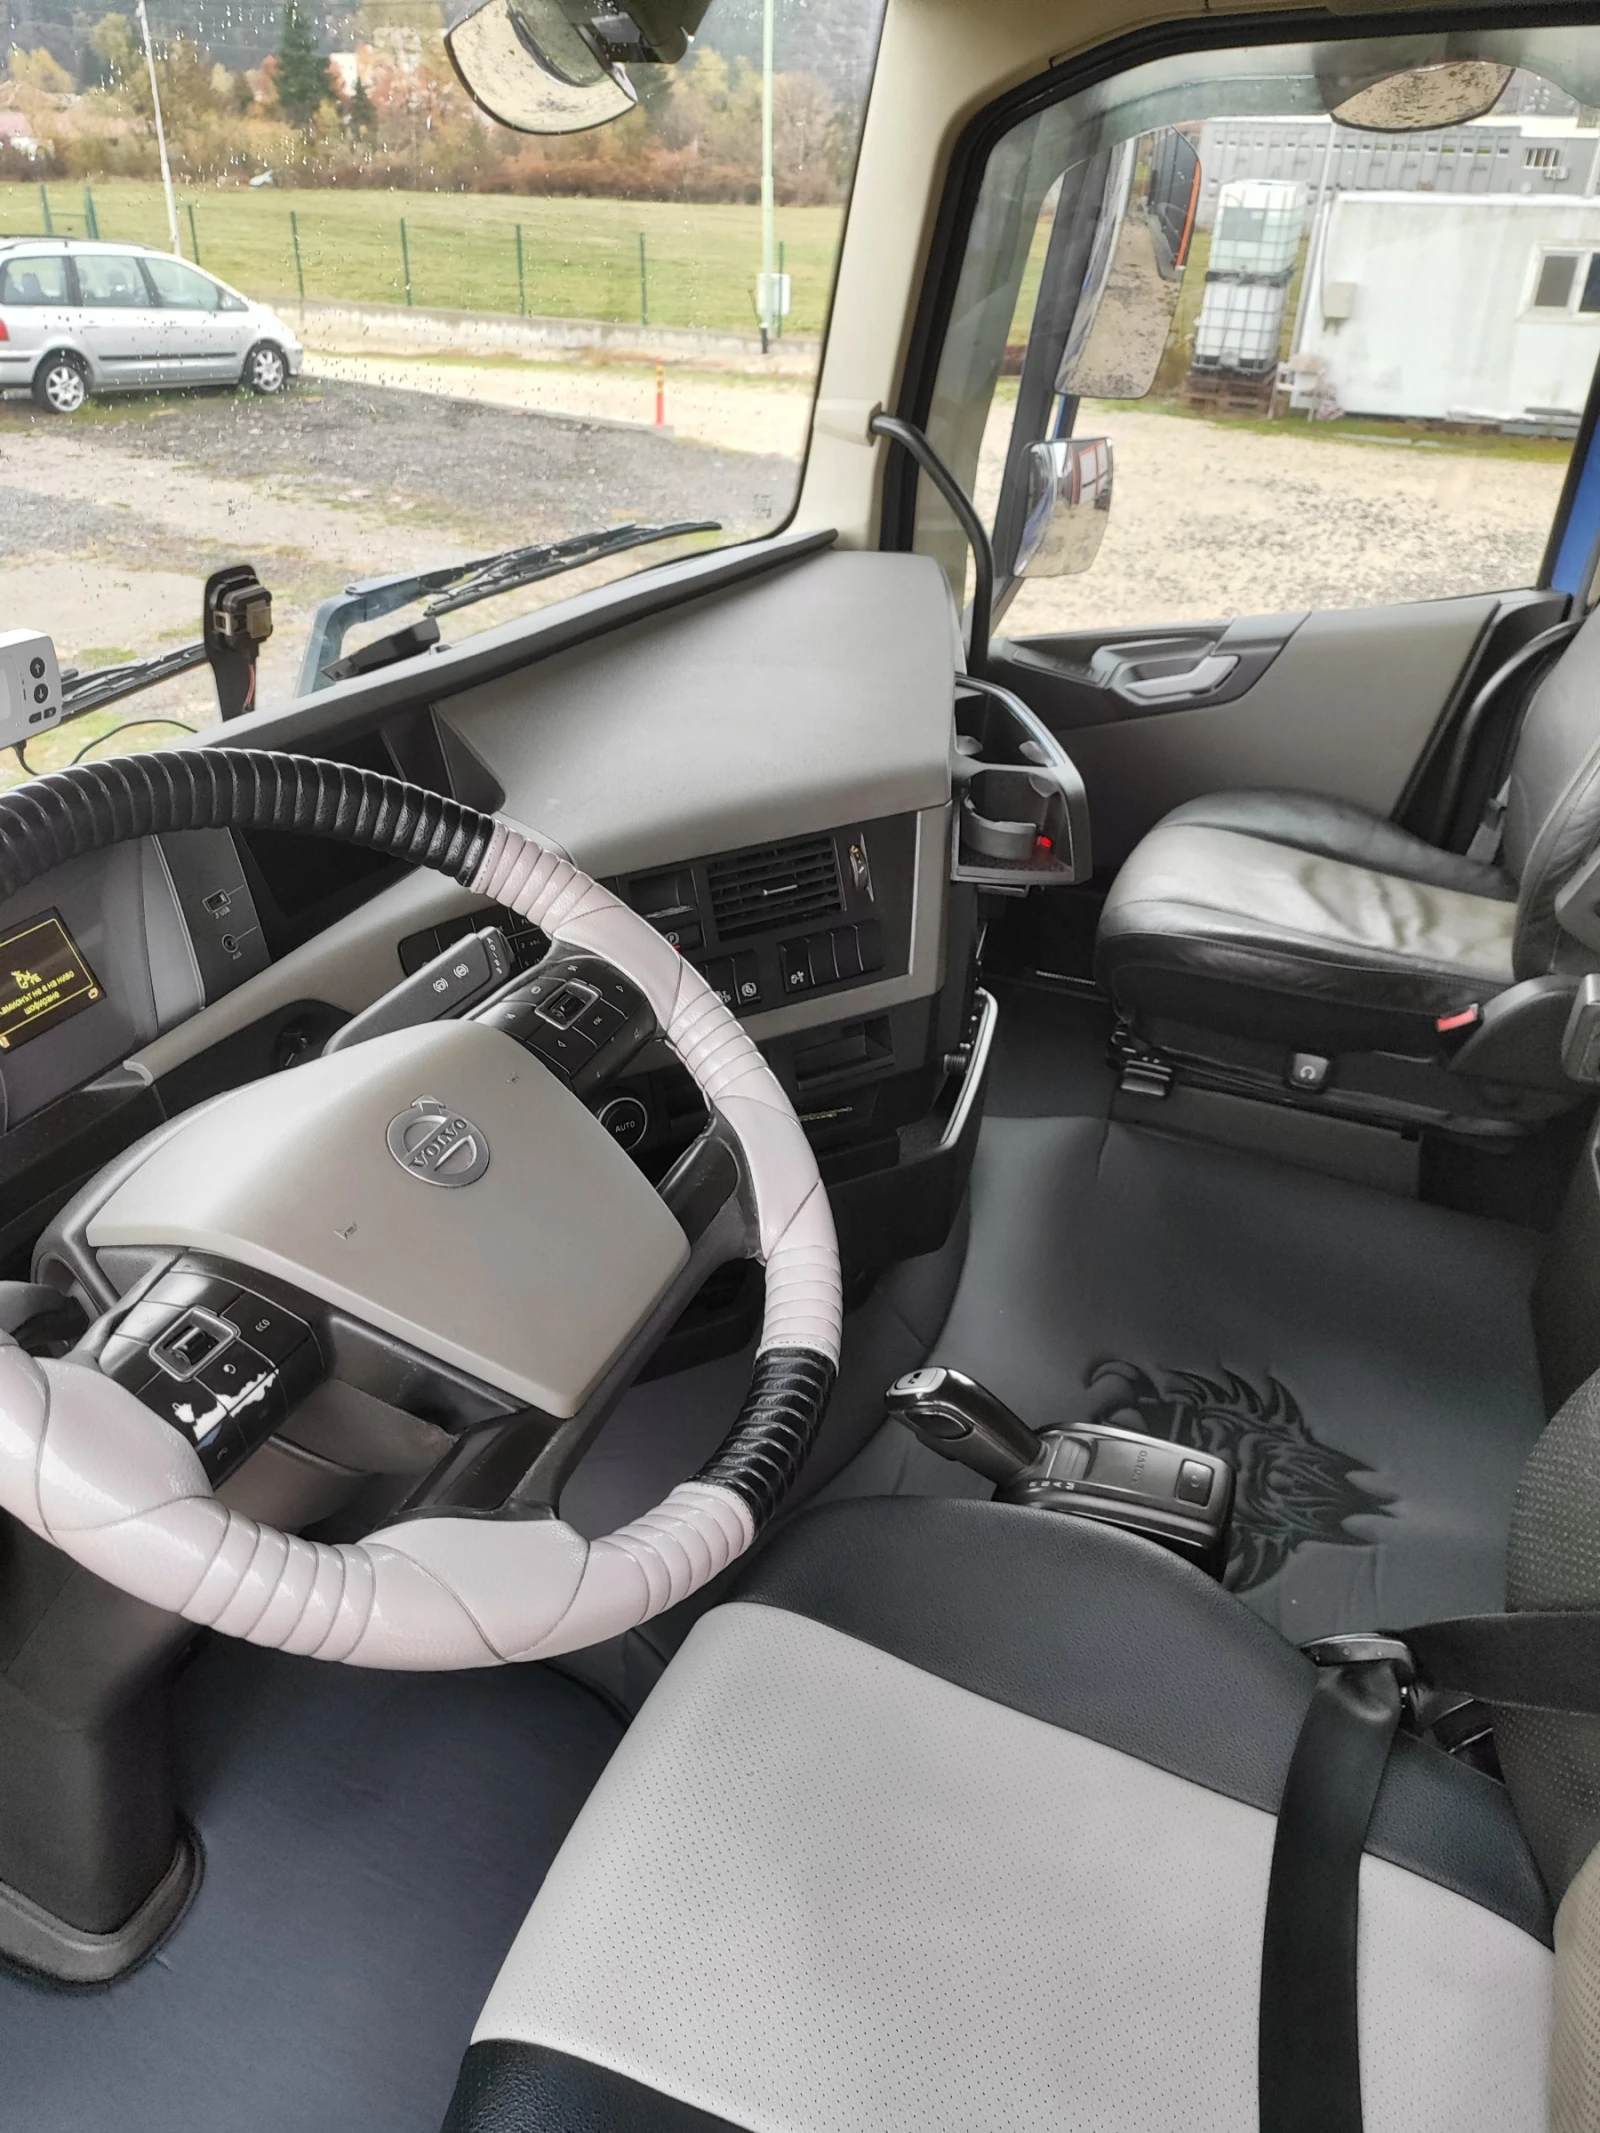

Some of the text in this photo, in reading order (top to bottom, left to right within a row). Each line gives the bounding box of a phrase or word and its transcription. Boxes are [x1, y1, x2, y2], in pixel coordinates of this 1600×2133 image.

[615, 1120, 636, 1133] AUTO
[409, 1118, 468, 1168] VOLVO
[255, 1318, 271, 1332] ECO
